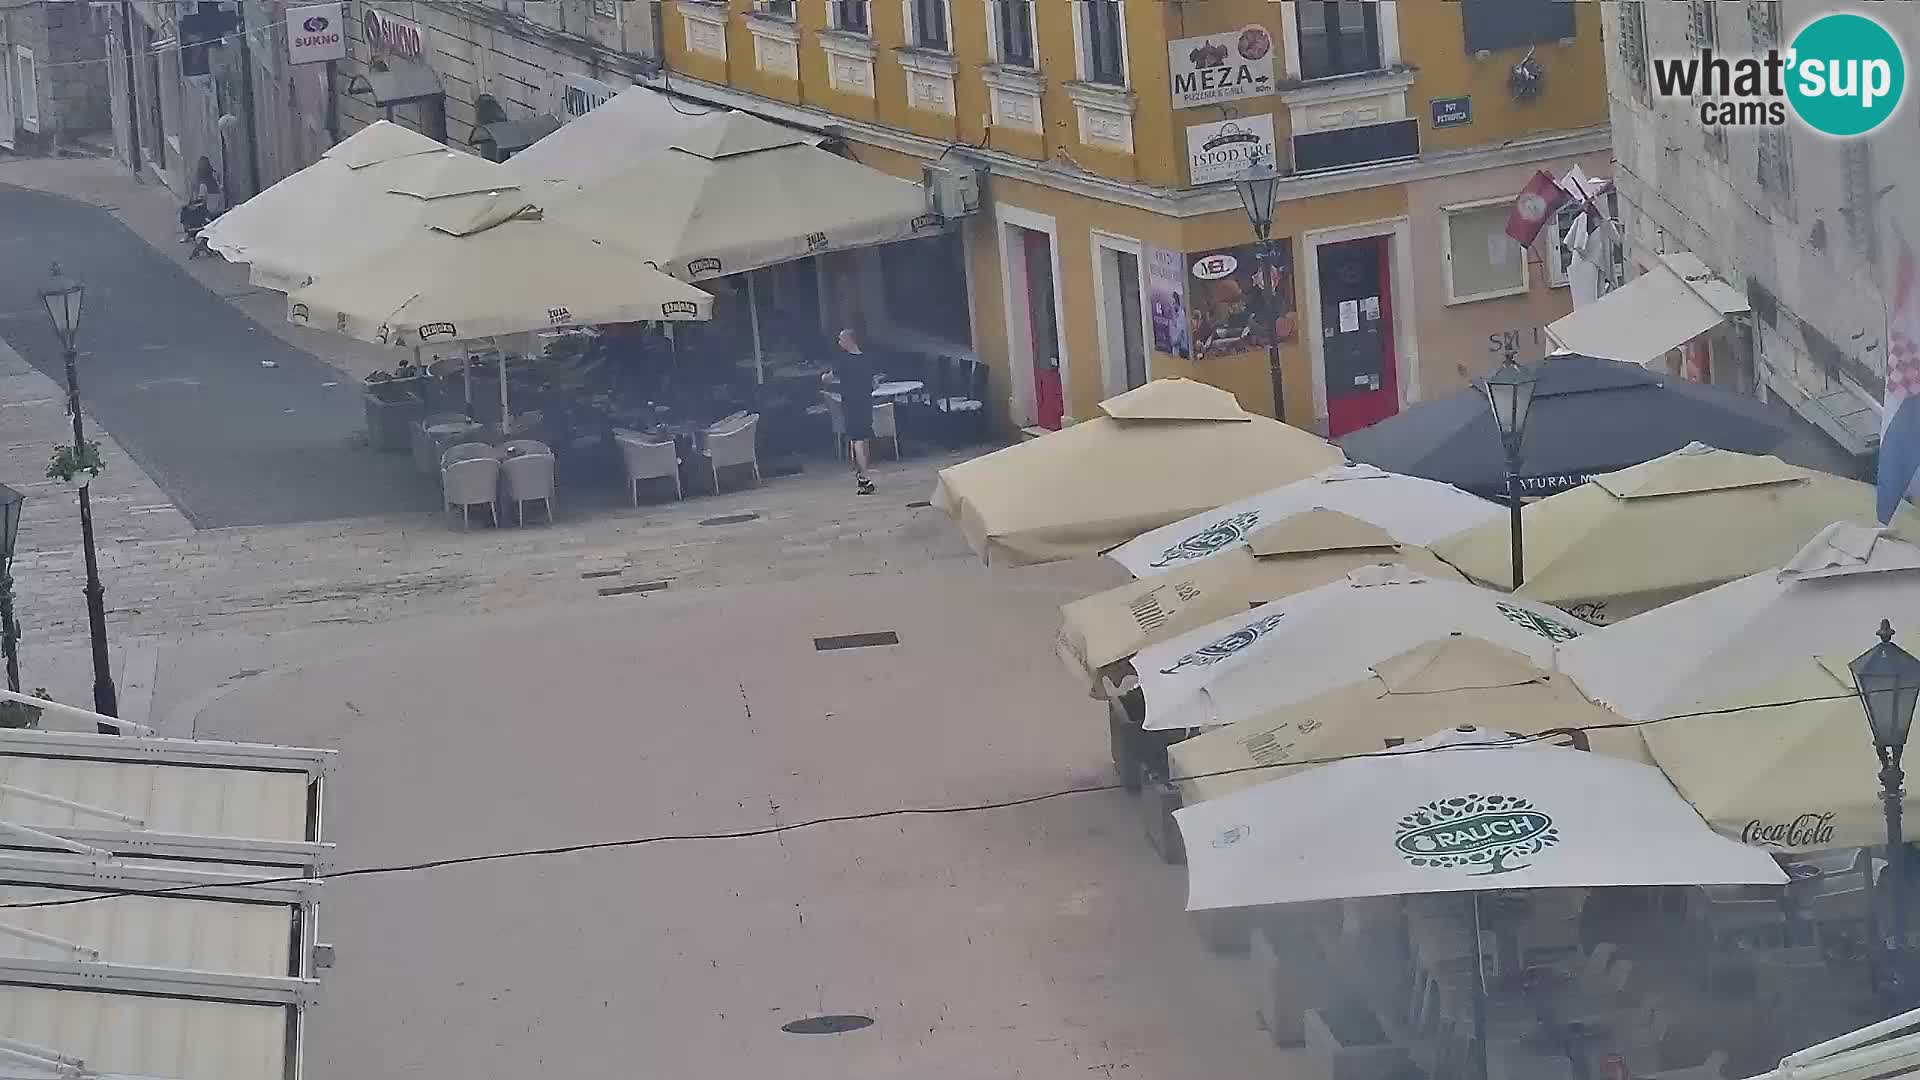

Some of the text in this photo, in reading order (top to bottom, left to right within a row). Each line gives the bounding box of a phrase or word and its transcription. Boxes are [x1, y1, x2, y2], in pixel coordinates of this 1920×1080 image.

[295, 33, 340, 48] SUKNO
[381, 16, 420, 57] SUKNO
[1175, 64, 1253, 95] MEZA
[1193, 148, 1240, 167] ISPOD
[1506, 475, 1576, 492] ATURAL
[1436, 816, 1535, 848] RAUCH
